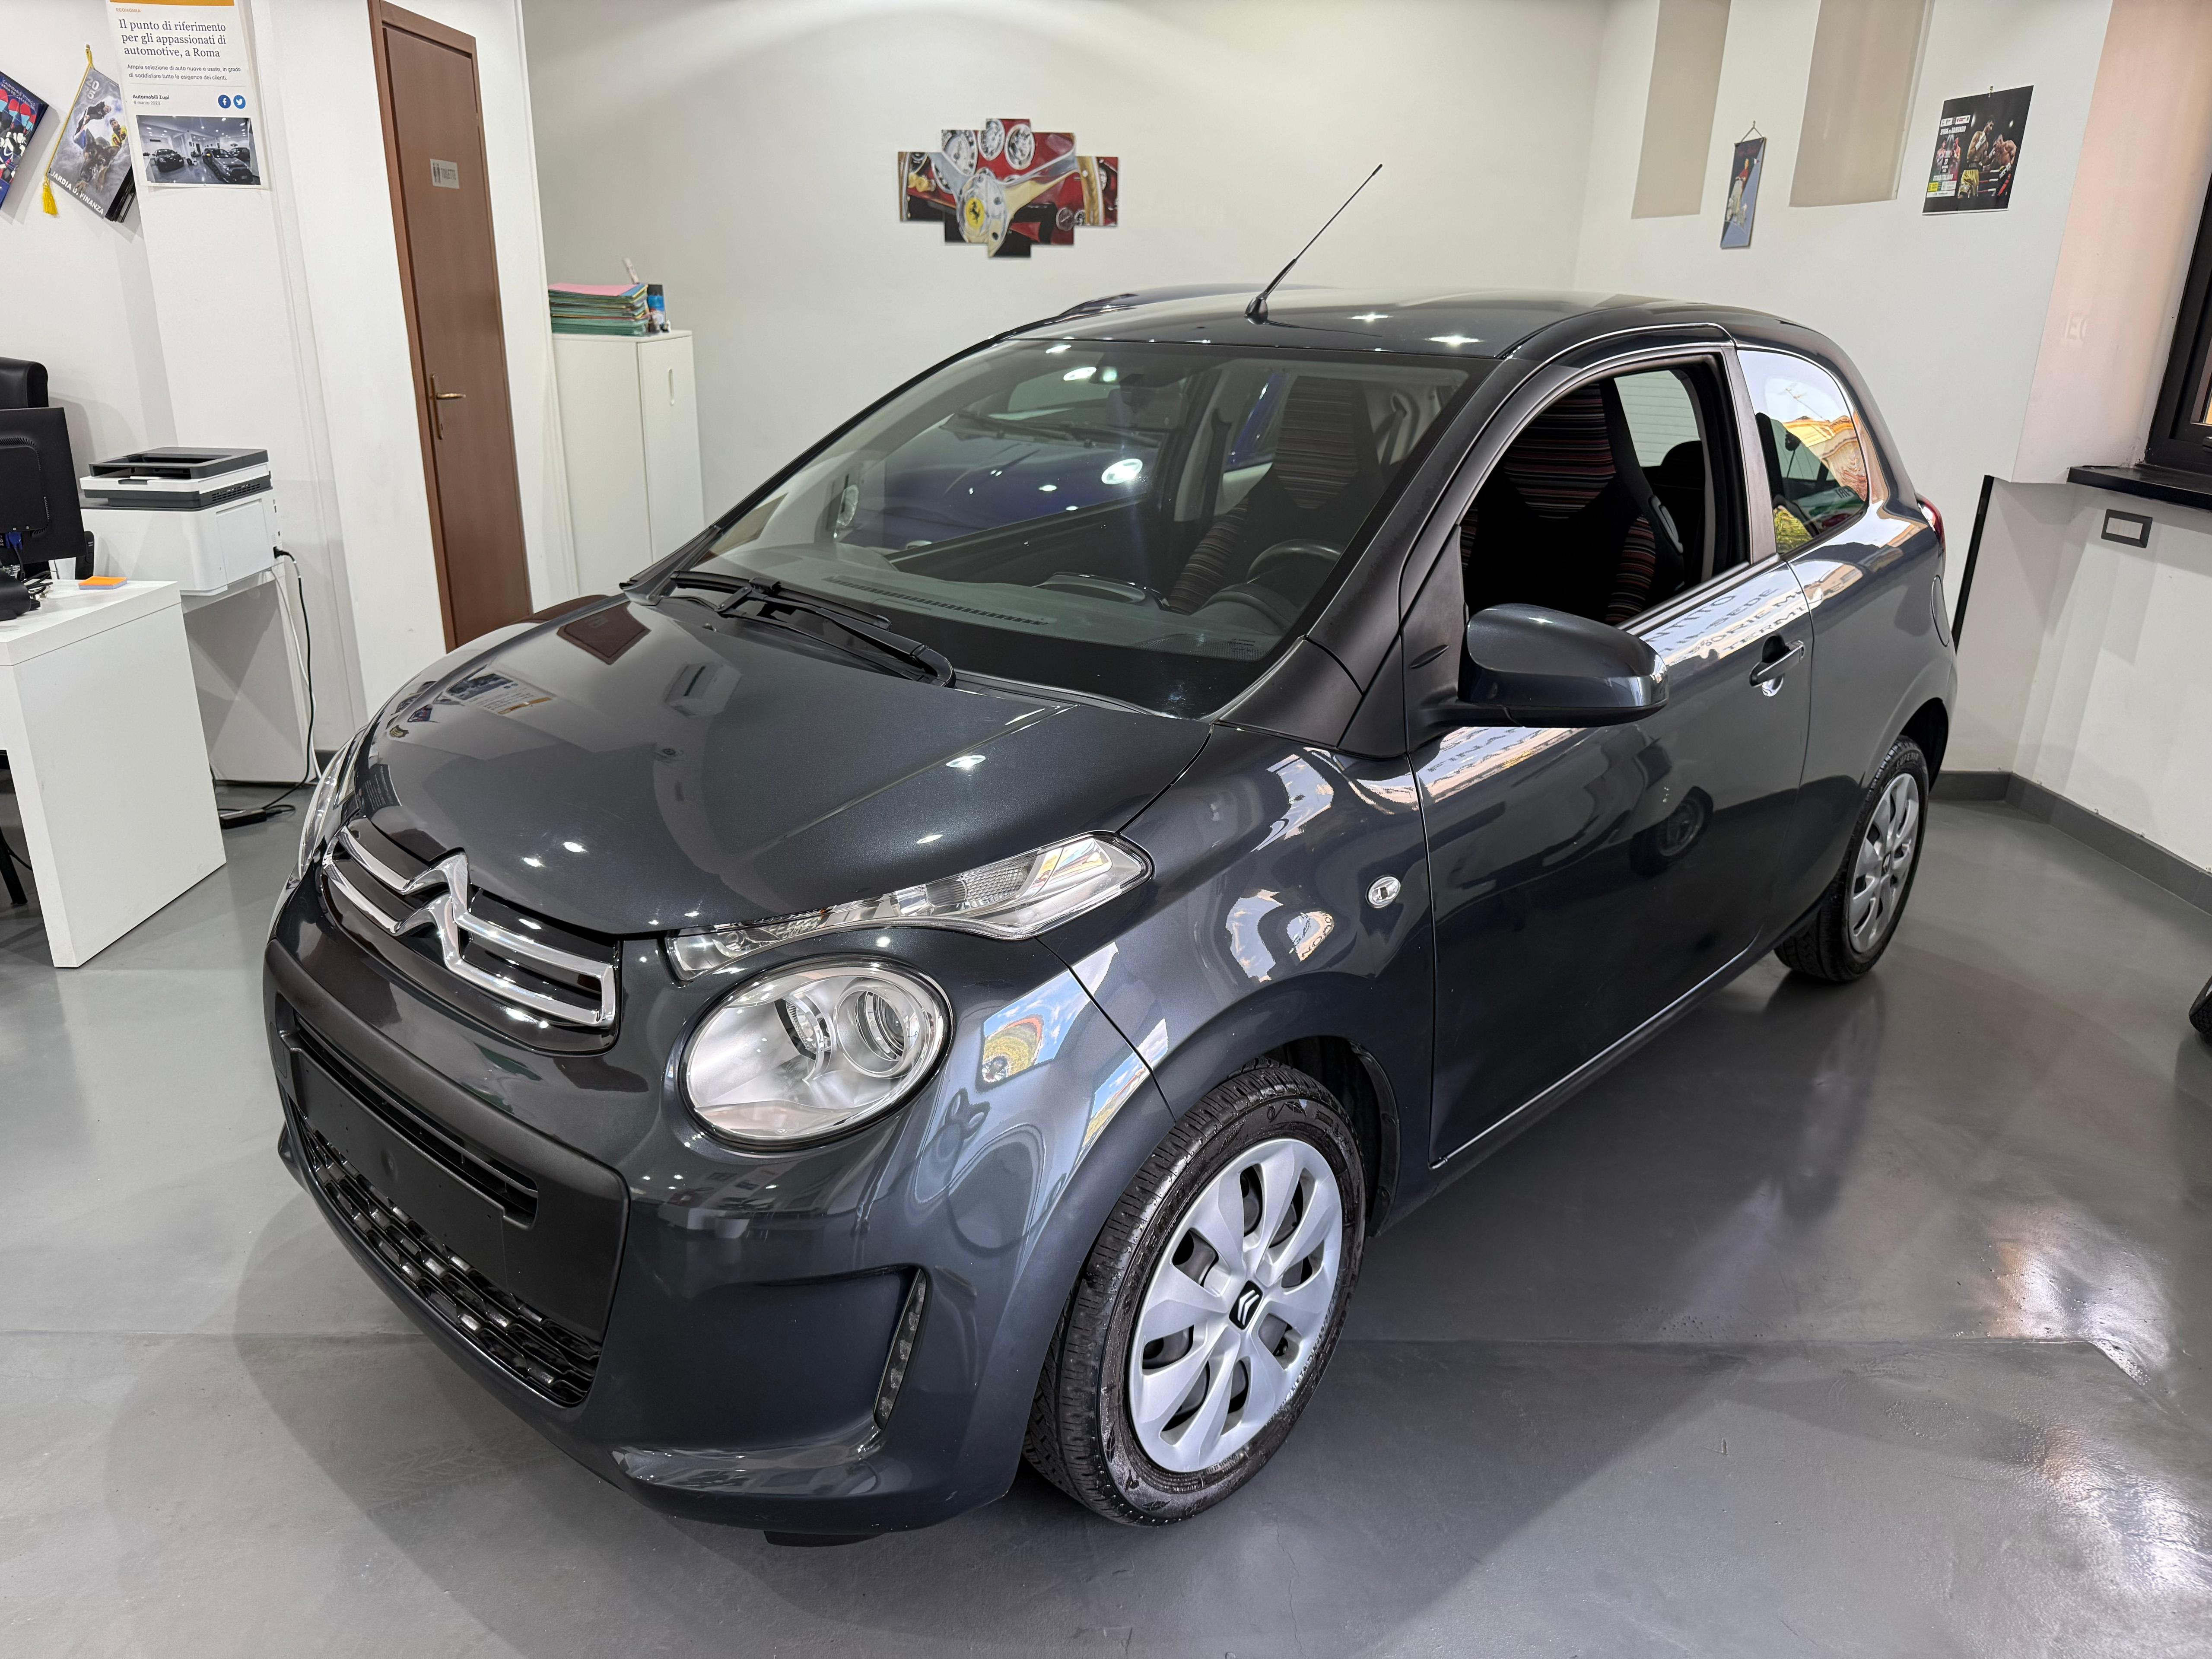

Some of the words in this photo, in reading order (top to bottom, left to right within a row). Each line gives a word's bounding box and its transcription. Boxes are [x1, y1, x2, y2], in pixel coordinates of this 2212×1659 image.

[118, 19, 127, 29] Il
[130, 22, 159, 31] punto
[162, 21, 172, 30] di
[174, 22, 226, 32] riferimento
[121, 35, 138, 44] per
[141, 33, 154, 44] gli
[156, 35, 215, 45] appassionati
[218, 35, 226, 44] di
[124, 47, 183, 58] automotive,
[193, 48, 220, 57] Roma
